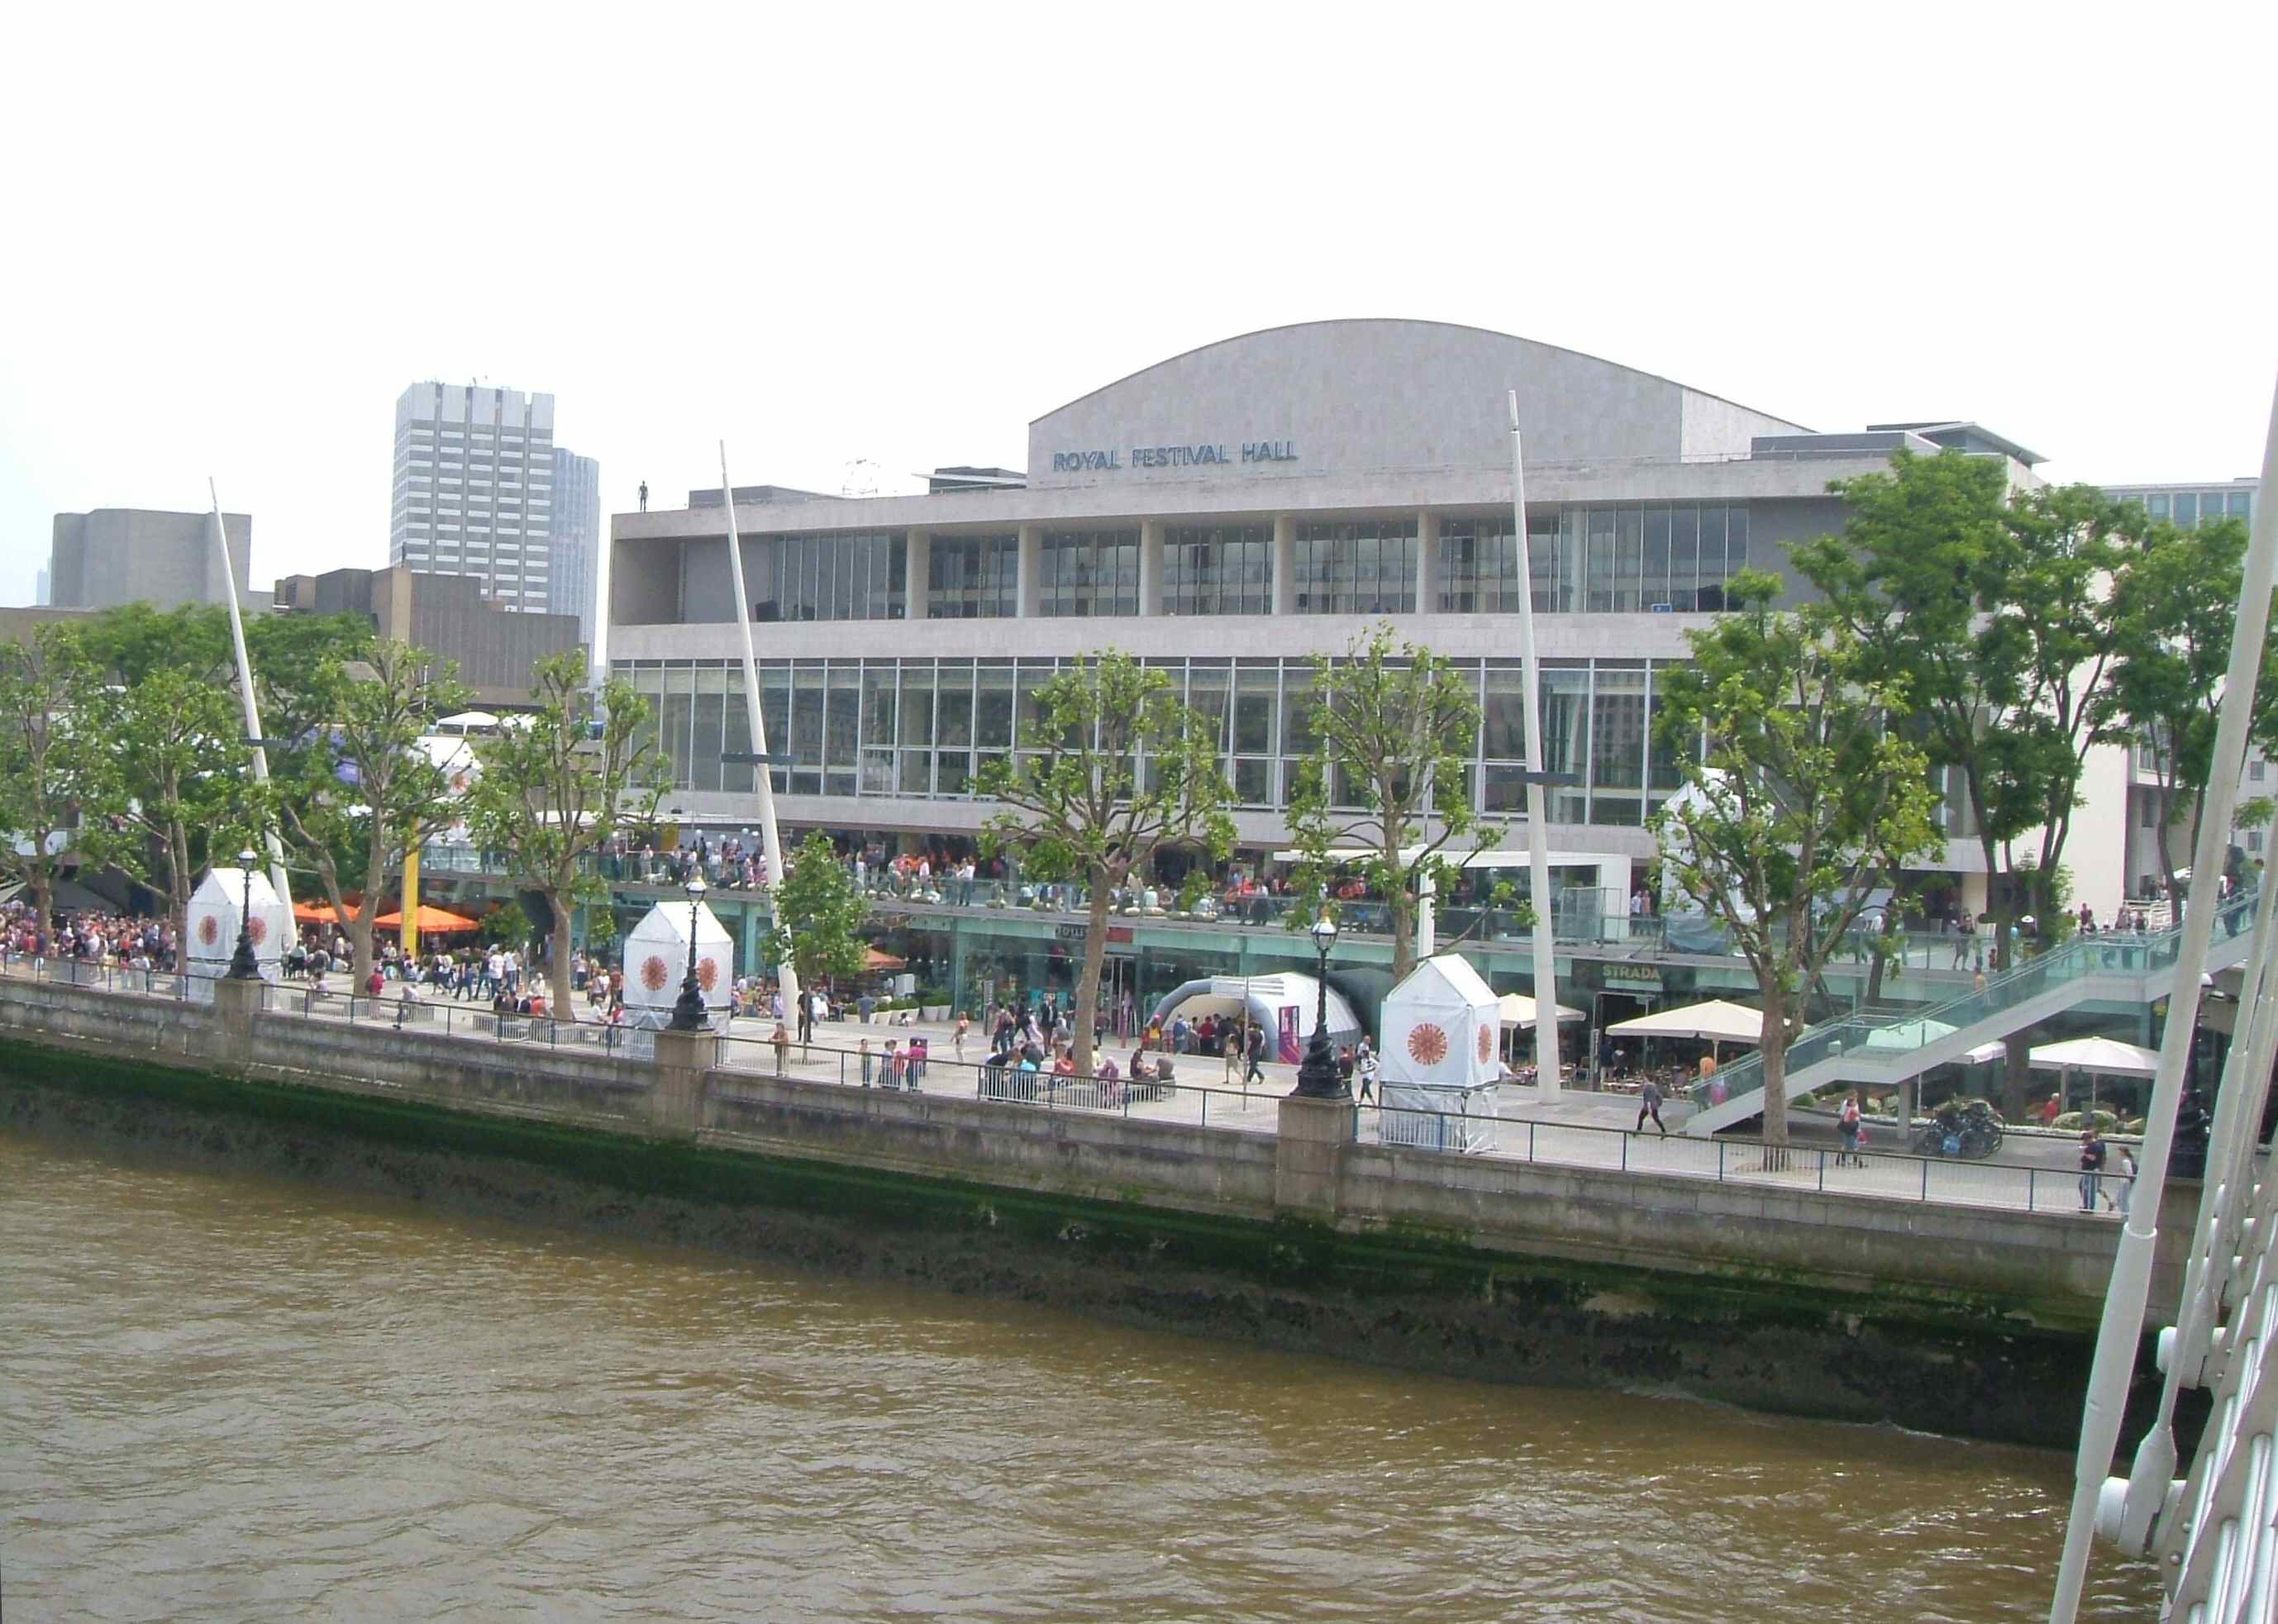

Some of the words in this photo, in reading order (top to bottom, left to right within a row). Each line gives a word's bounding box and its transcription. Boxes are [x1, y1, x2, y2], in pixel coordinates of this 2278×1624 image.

[1052, 449, 1122, 471] ROYAL
[1132, 443, 1230, 469] FESTIVAL
[1241, 441, 1299, 463] HALL
[1603, 964, 1661, 979] STRADA
